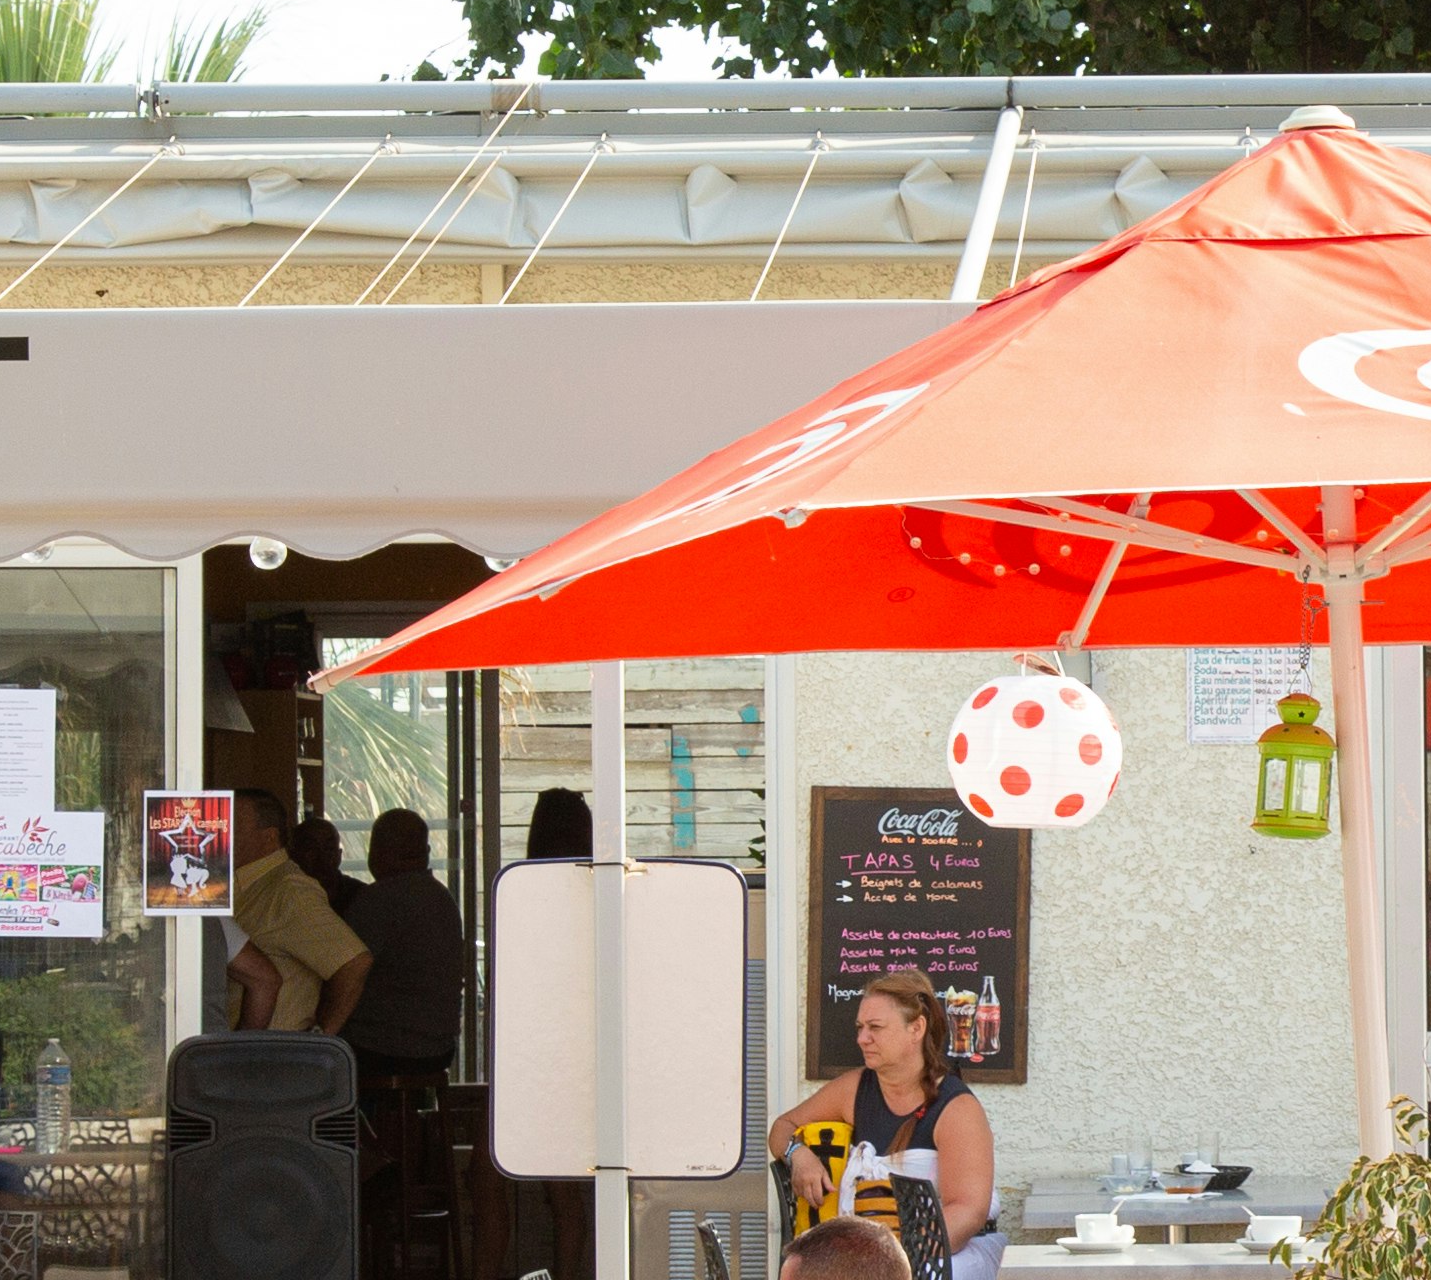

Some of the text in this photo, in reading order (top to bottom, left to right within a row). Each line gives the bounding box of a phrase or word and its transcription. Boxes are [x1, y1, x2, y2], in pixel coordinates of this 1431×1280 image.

[1194, 655, 1210, 665] Jus
[1212, 655, 1222, 664] de
[1225, 655, 1251, 664] fruits
[1194, 665, 1218, 674] Soda
[1194, 676, 1212, 685] Eau
[1194, 686, 1213, 694] Eau
[1214, 687, 1251, 696] gazeuse
[1194, 707, 1249, 718] Plat du jour
[1194, 716, 1242, 725] Sandwich
[163, 817, 185, 829] STAR
[878, 807, 963, 836] Coca-Cola
[840, 853, 914, 870] TAPAS
[930, 855, 940, 870] 4
[861, 876, 904, 890] Beignets
[908, 879, 922, 889] de
[904, 893, 917, 902] de
[887, 931, 900, 940] de
[966, 930, 985, 939] 10
[988, 928, 1012, 939] Euros
[927, 947, 944, 955] 10
[948, 944, 977, 955] Euros
[927, 961, 947, 972] 20
[948, 961, 979, 972] Euros
[828, 984, 865, 1003] Magnu
